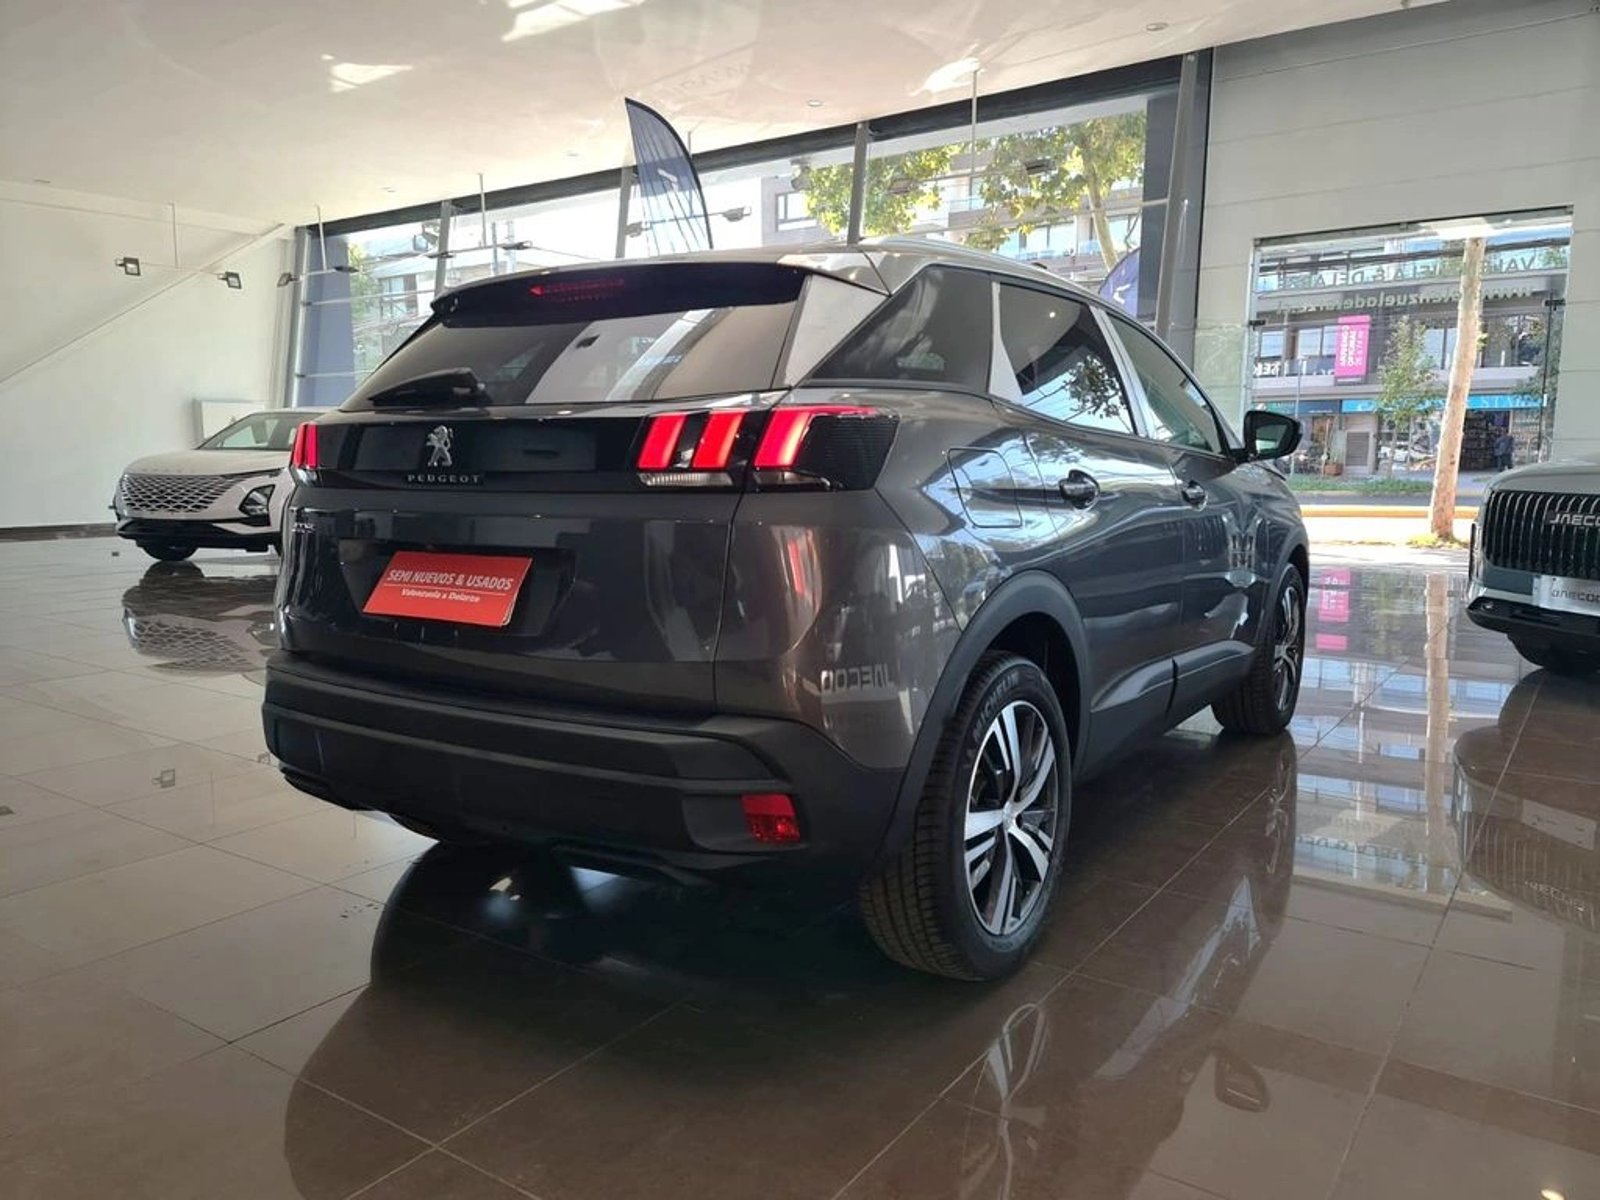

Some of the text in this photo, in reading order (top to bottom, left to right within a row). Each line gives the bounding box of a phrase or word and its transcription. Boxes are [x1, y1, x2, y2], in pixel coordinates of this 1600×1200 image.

[407, 474, 481, 484] PEUGEOT
[387, 570, 514, 591] SEMI NUEVOS & USADOS
[972, 671, 1020, 744] MICHELIN
